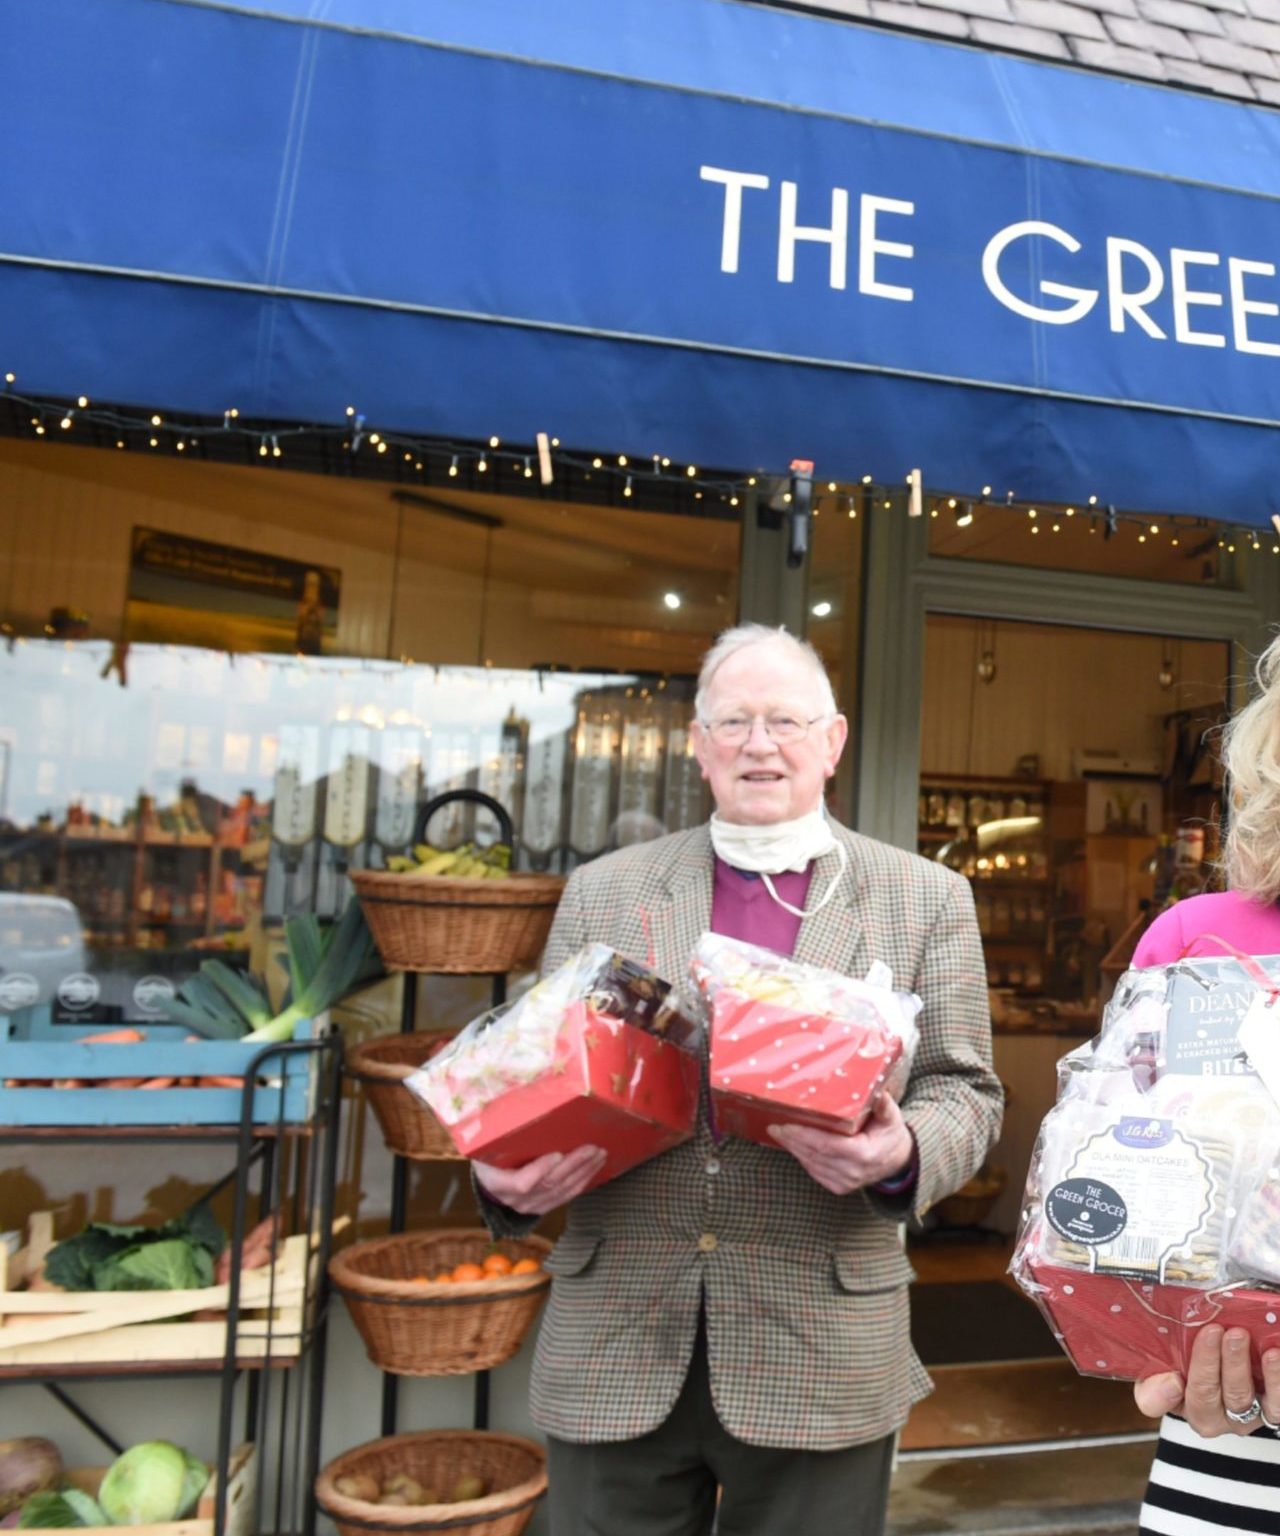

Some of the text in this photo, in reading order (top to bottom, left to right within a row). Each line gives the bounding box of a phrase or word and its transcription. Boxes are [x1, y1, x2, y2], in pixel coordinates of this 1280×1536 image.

[700, 165, 914, 301] THE
[1054, 1187, 1126, 1219] GREEN GROCER
[1086, 1185, 1102, 1199] THE
